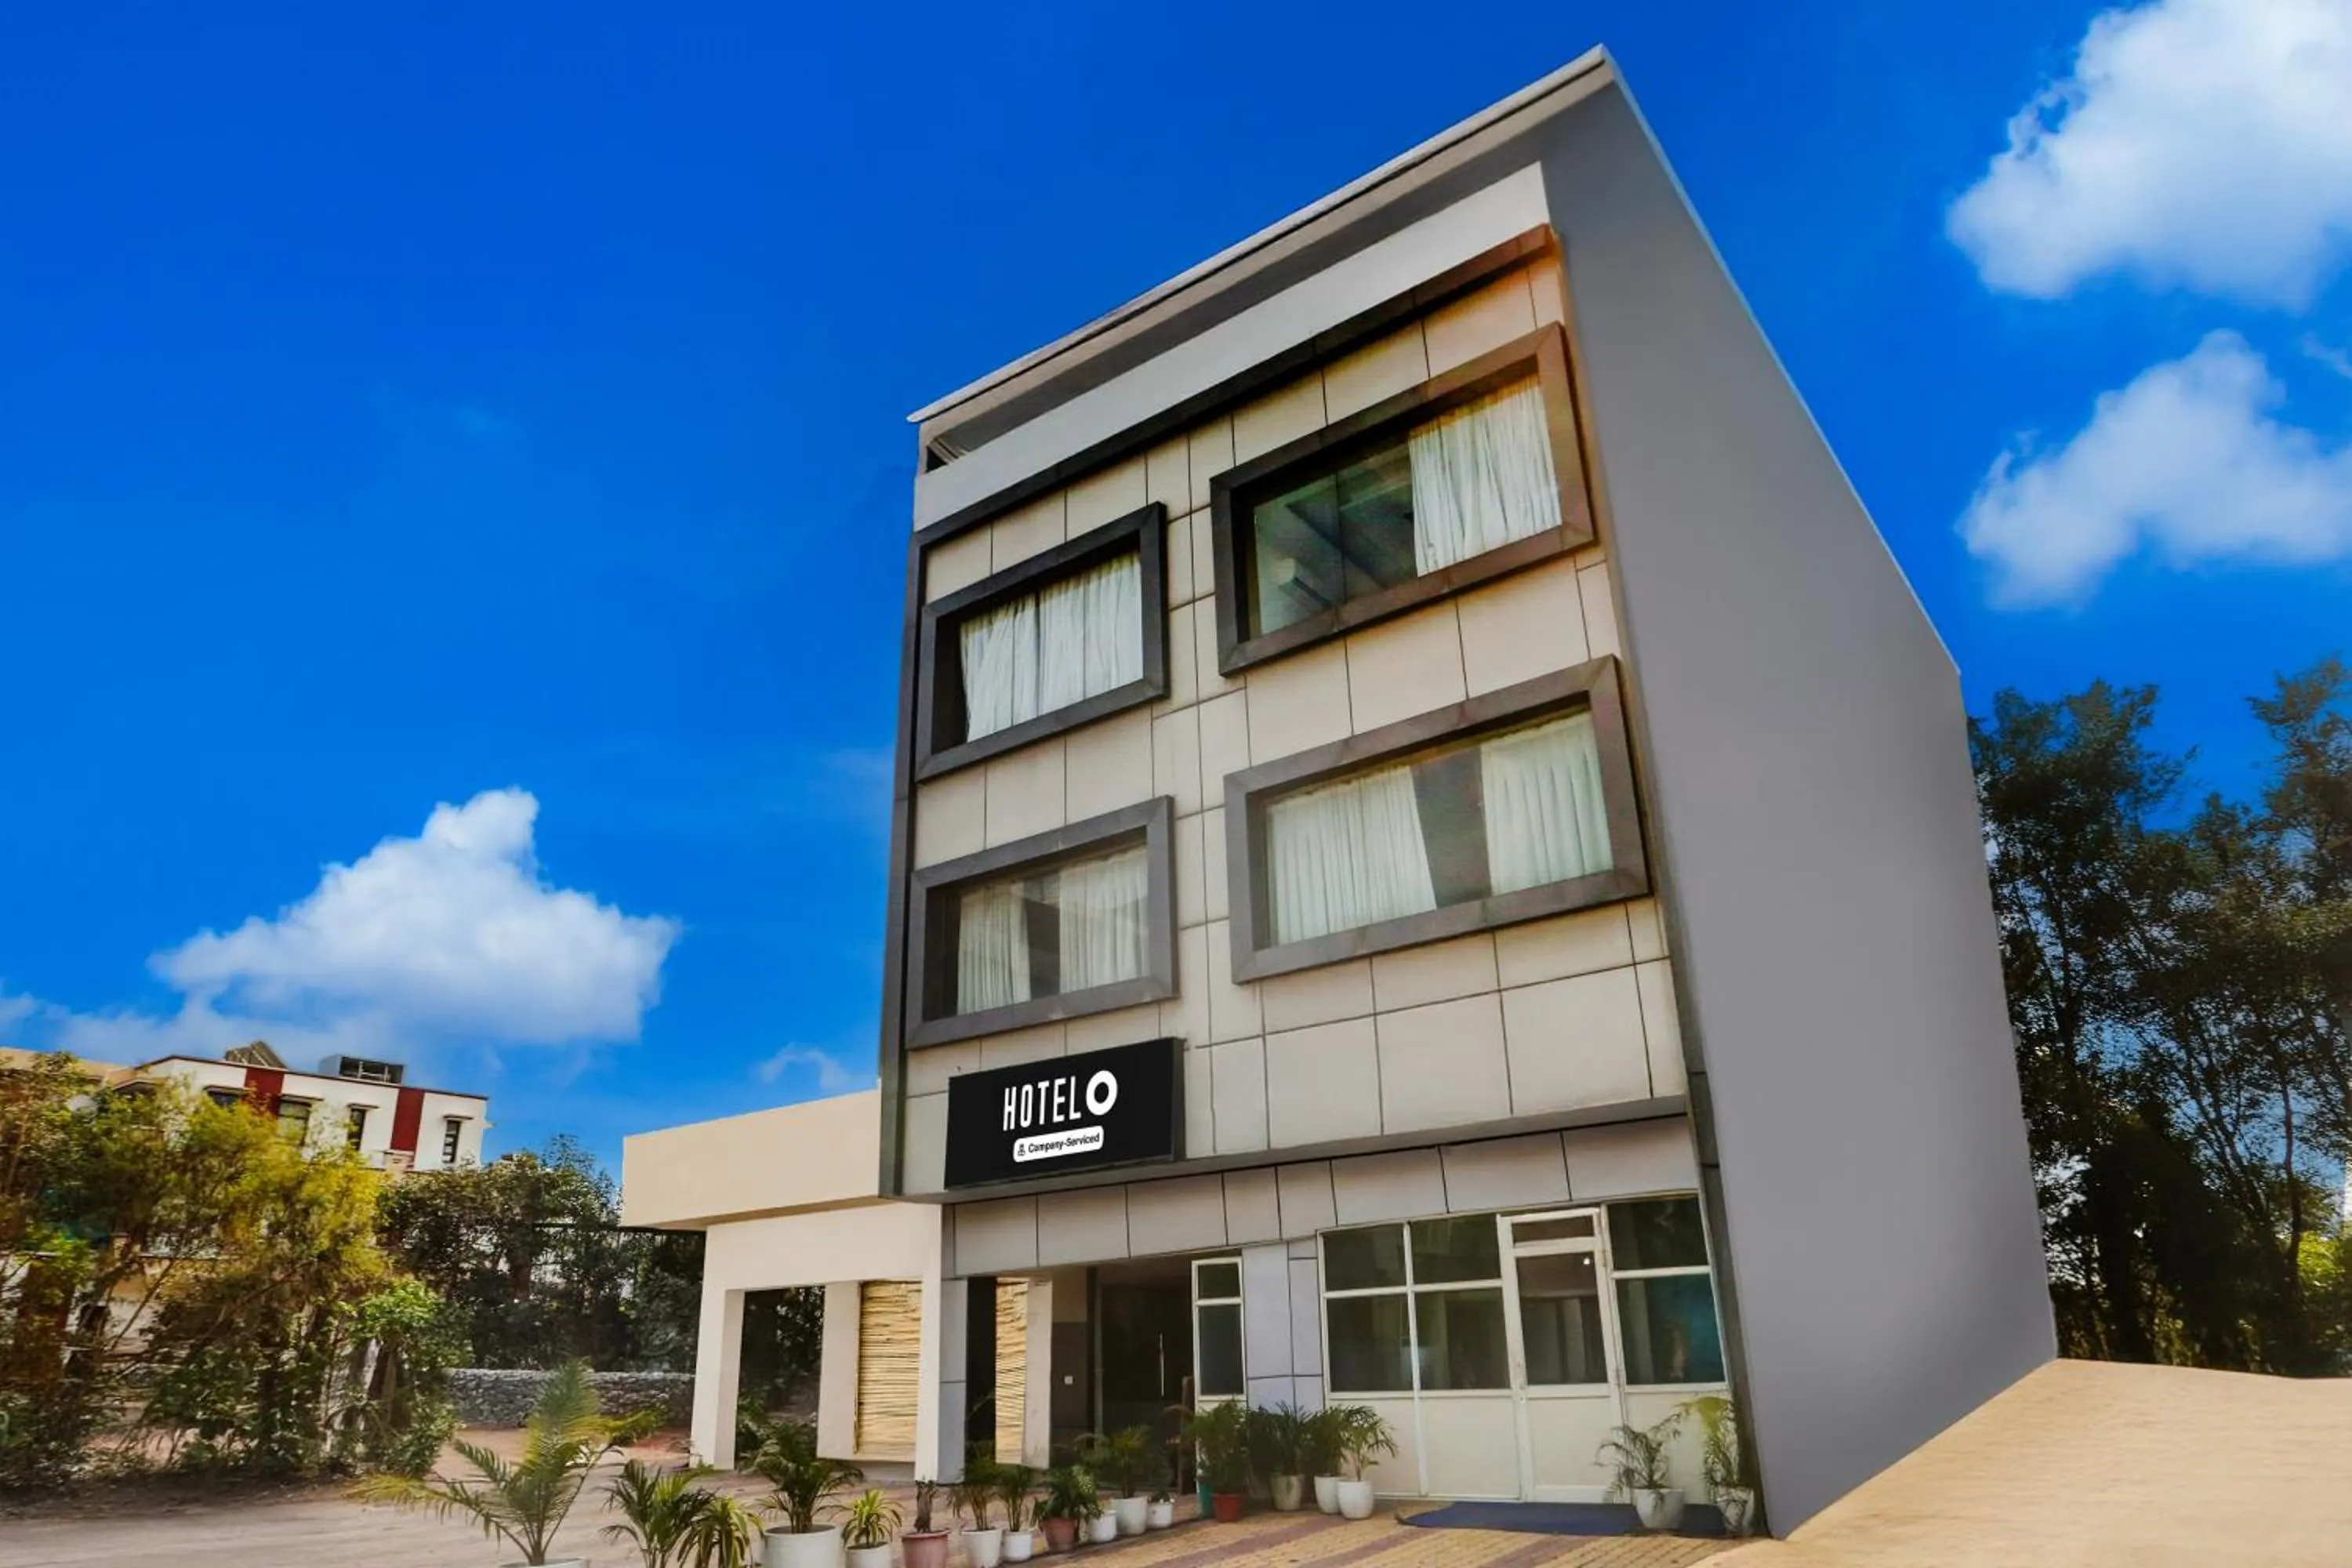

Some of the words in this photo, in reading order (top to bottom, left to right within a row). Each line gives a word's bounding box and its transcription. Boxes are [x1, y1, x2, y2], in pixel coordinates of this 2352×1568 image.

[1003, 1076, 1082, 1131] HOTEL
[1086, 1070, 1118, 1116] O
[1028, 1132, 1100, 1154] Company-Serviced
